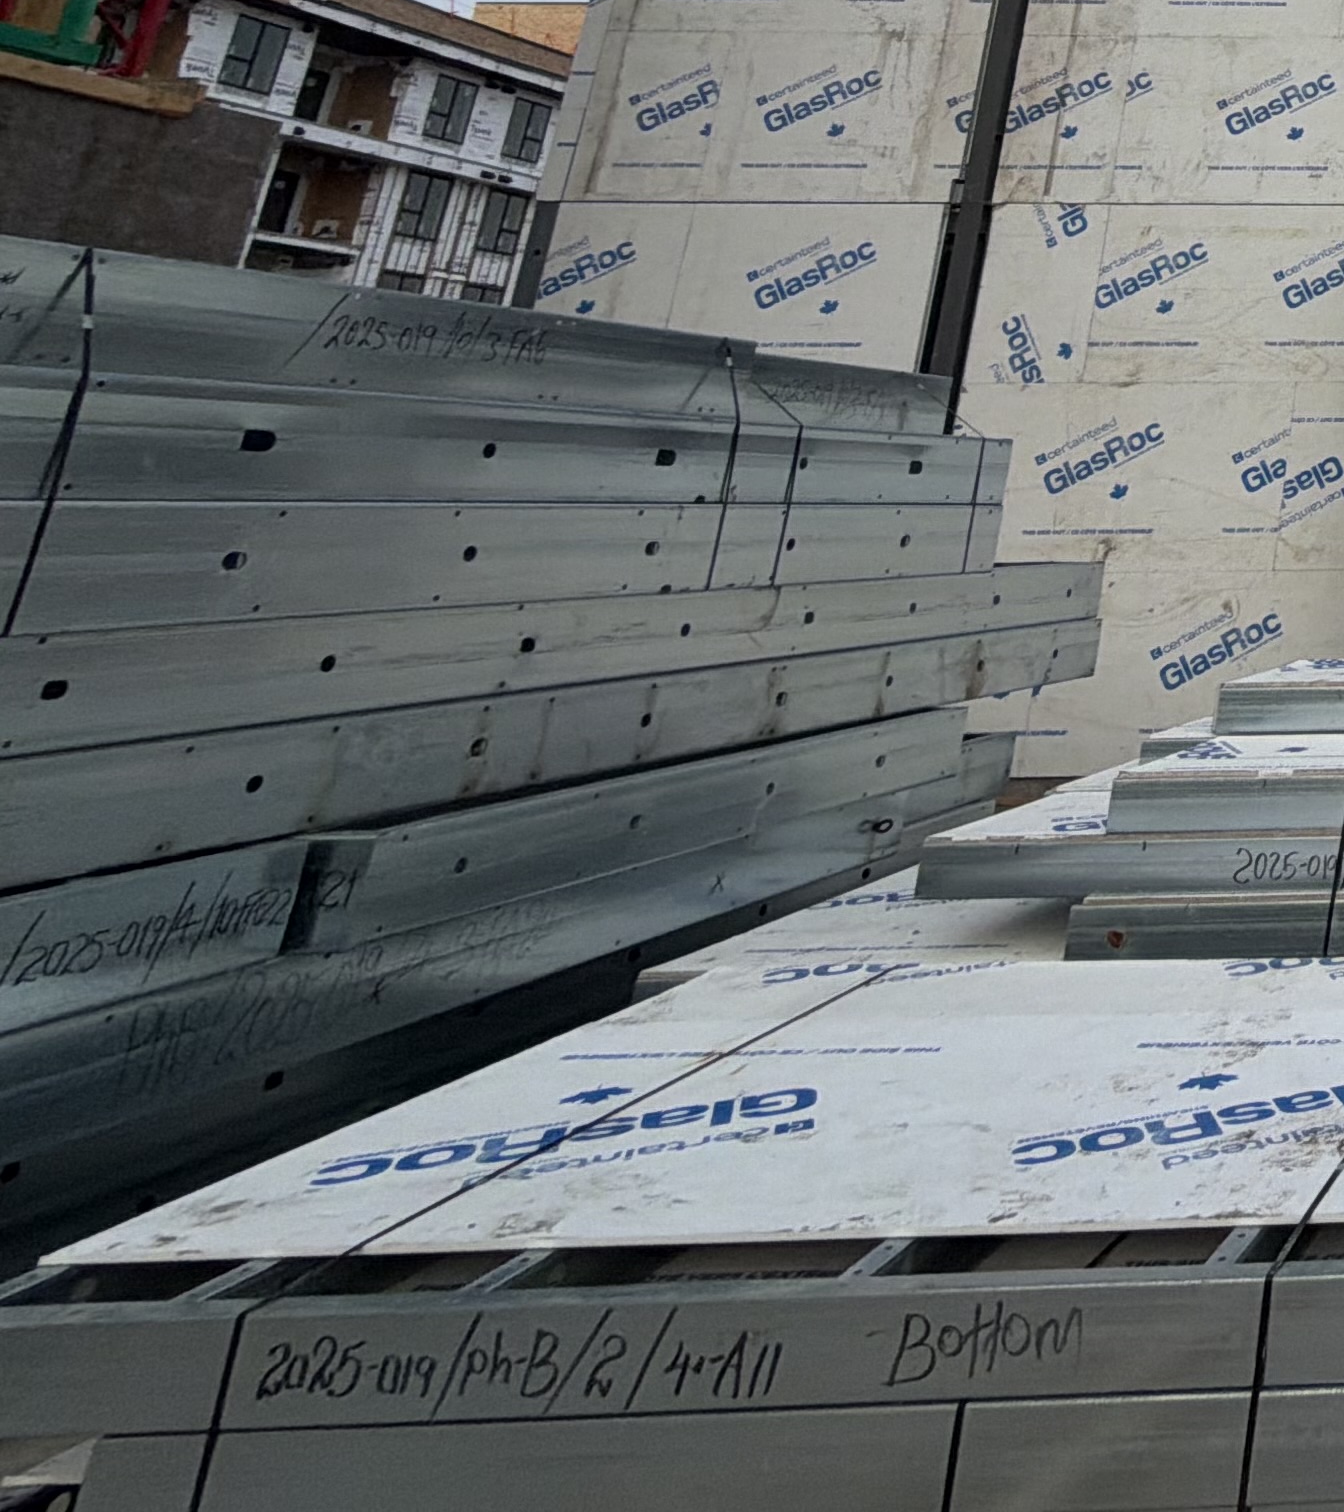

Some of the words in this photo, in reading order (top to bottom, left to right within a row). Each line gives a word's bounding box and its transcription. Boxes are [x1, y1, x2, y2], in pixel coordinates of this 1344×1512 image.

[636, 79, 720, 133] GlasR
[762, 69, 883, 133] GlasRoc
[1225, 73, 1336, 136] GlasRoc
[537, 241, 637, 299] lasRoc
[754, 241, 877, 311] GlasRoc
[1094, 242, 1209, 311] GlasRoc
[1043, 422, 1165, 495] GlasRoc
[1048, 417, 1118, 462] certainteed
[1281, 455, 1344, 501] Glas
[1159, 612, 1283, 691] GlasRoc
[310, 1087, 818, 1187] GlasRoc
